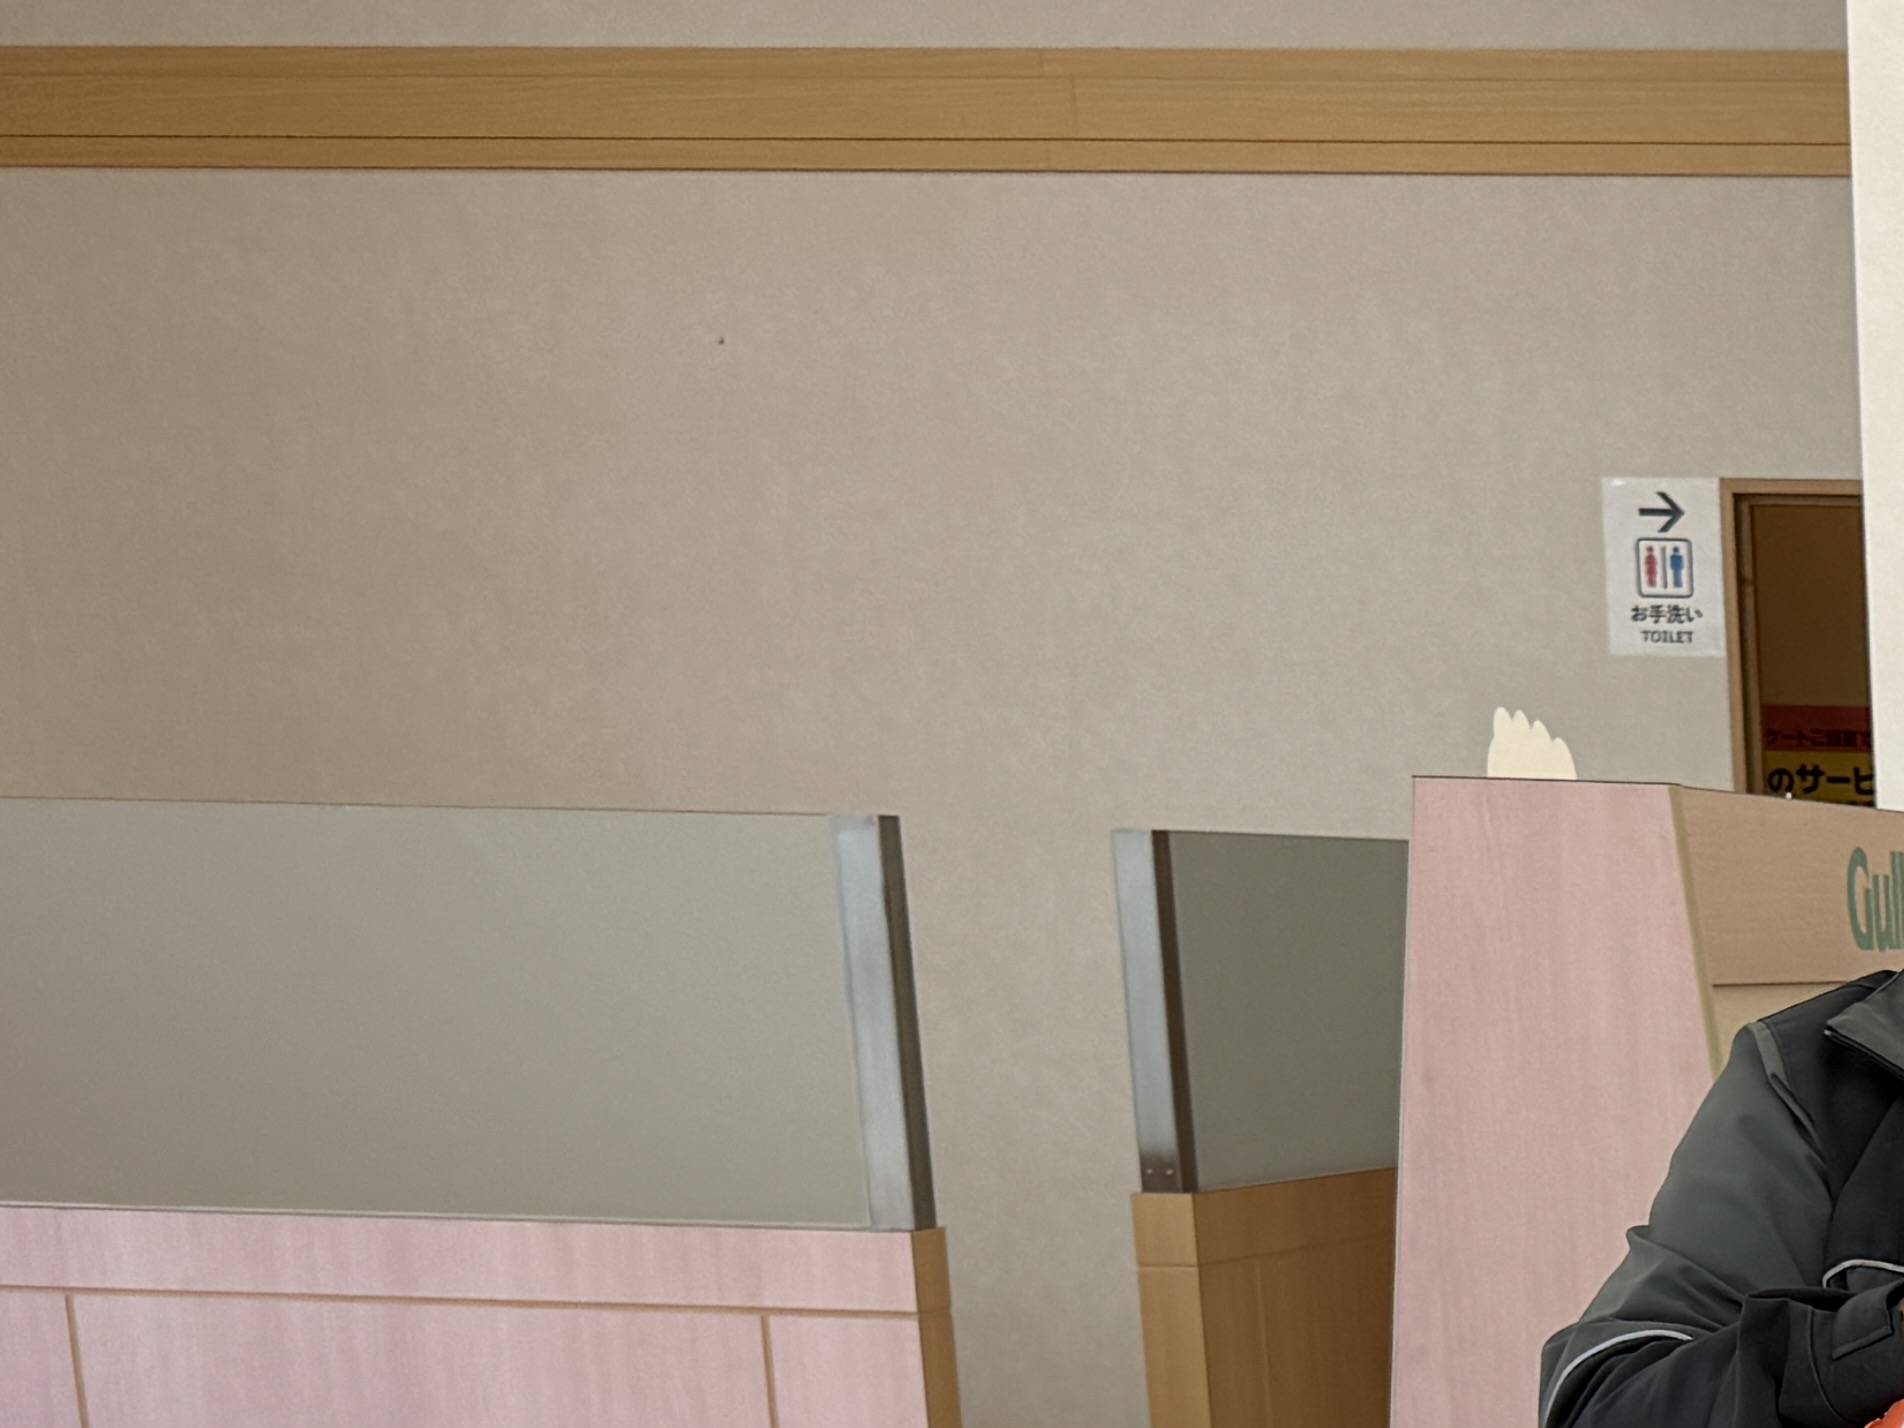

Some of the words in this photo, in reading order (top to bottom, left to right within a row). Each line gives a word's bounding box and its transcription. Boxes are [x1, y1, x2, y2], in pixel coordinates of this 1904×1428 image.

[1630, 604, 1703, 624] お手洗い
[1640, 630, 1694, 644] TOILET
